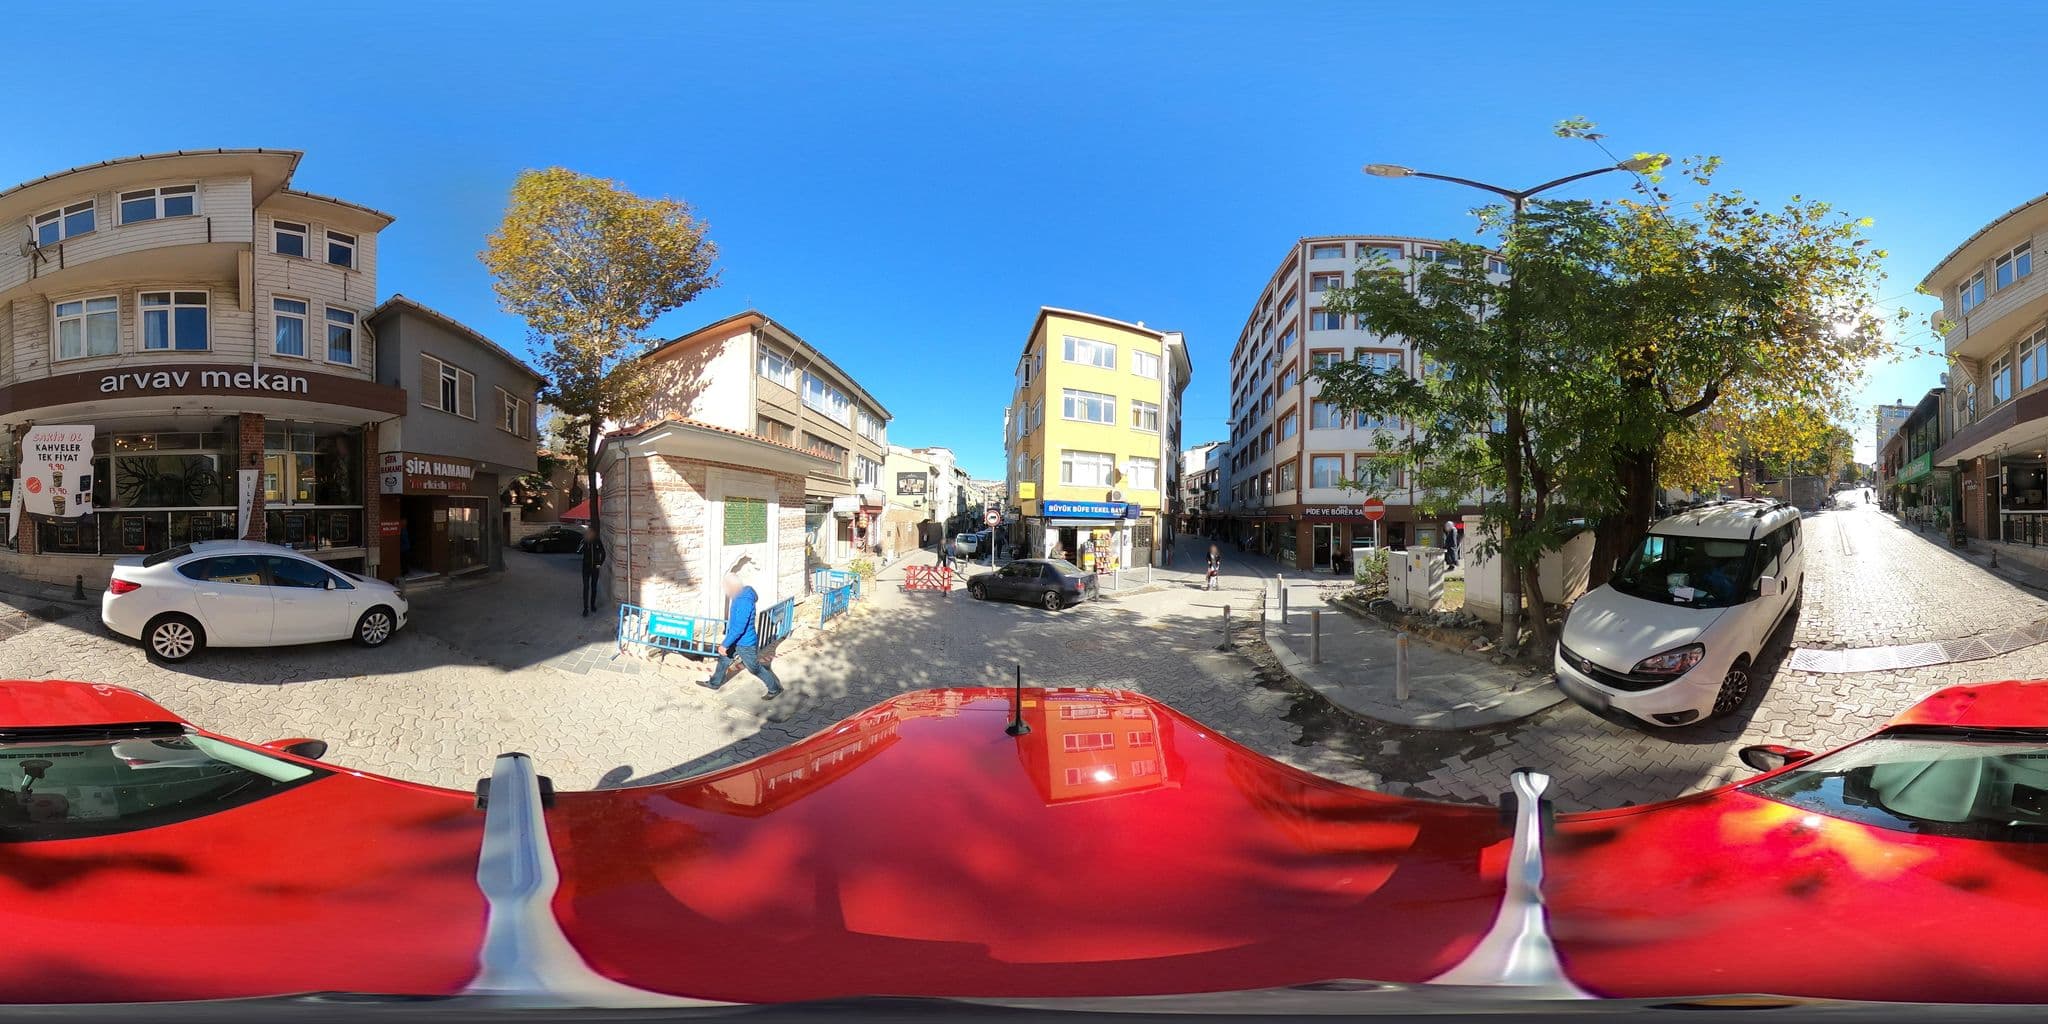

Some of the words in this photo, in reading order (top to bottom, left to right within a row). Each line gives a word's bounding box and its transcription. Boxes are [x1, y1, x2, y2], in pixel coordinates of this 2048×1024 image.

[100, 371, 190, 393] arvav
[201, 362, 308, 393] mekan
[35, 443, 81, 452] KAHVELER
[38, 453, 52, 461] TEK
[55, 451, 79, 462] FİYAT
[406, 457, 432, 476] ŞİFA
[433, 462, 471, 478] HAMAMI
[1048, 504, 1072, 513] BÜYÜK
[1072, 505, 1090, 513] BÜFE
[1091, 506, 1110, 514] TEKEL
